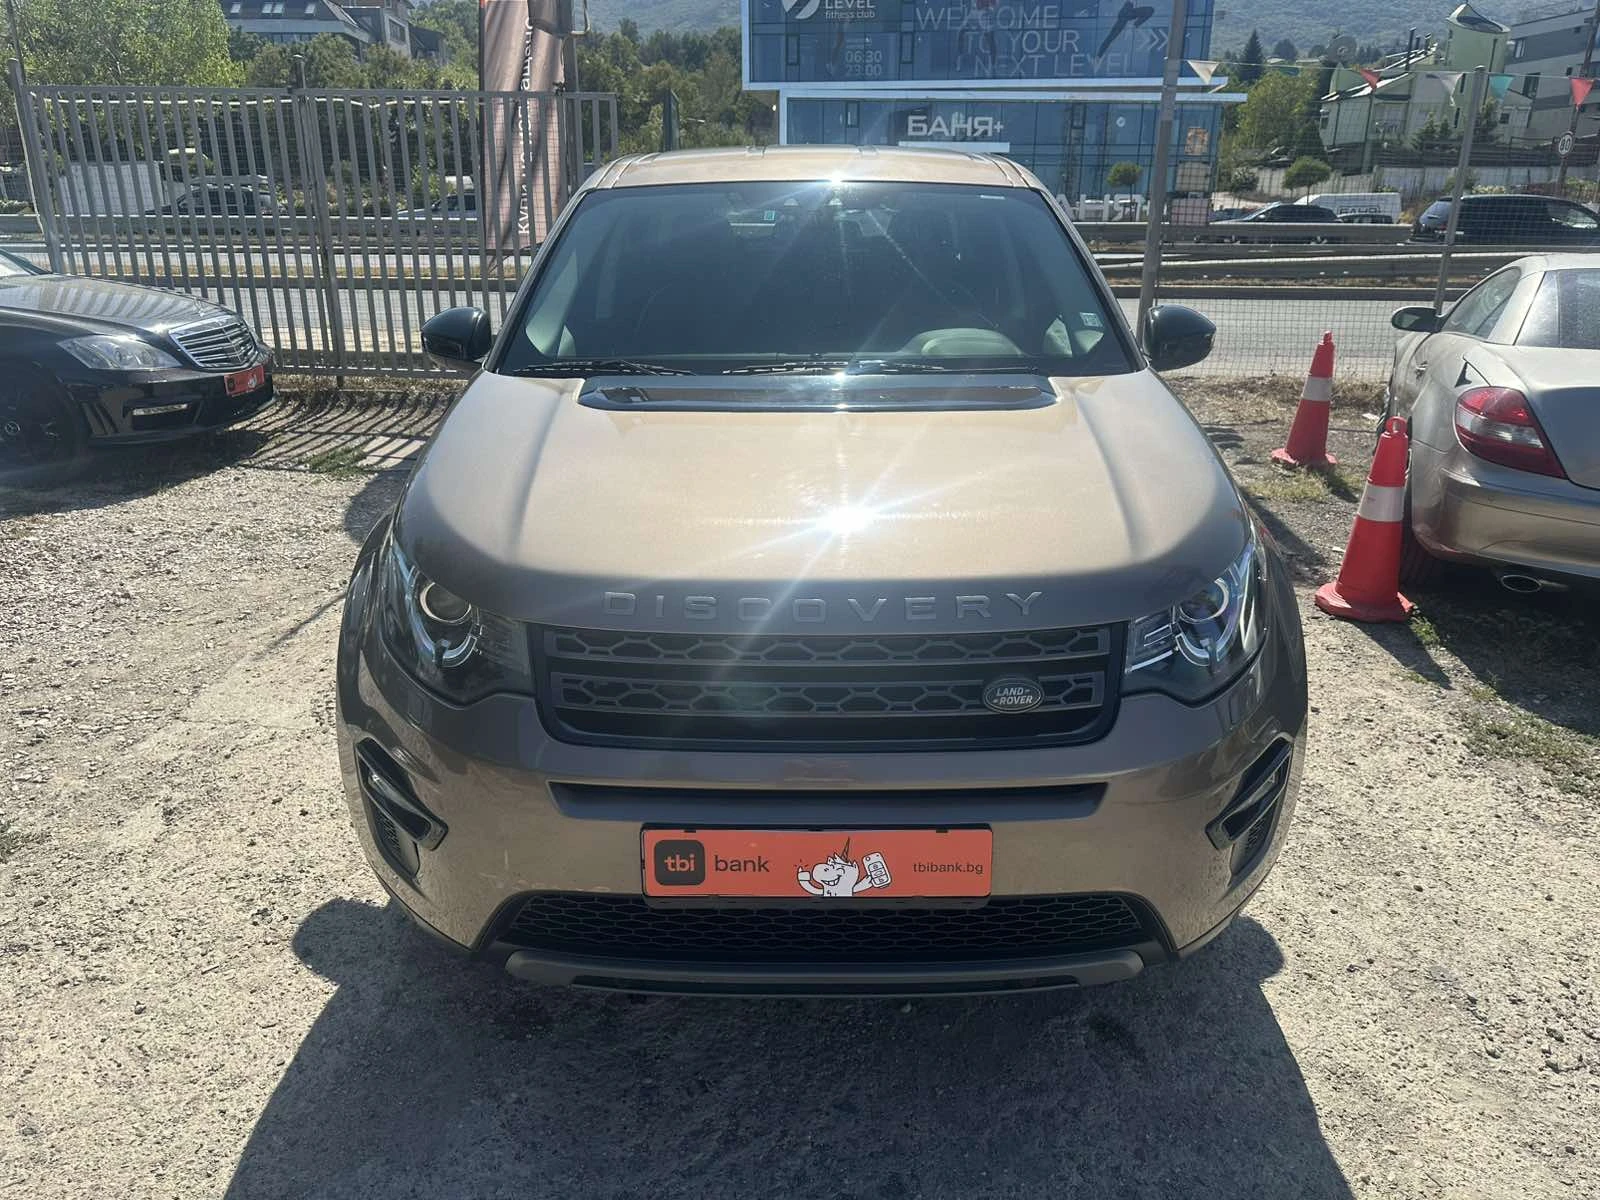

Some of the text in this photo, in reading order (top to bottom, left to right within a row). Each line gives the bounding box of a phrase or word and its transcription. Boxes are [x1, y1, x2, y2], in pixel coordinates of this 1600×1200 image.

[825, 0, 876, 9] LEVEL
[856, 9, 876, 18] club
[916, 5, 1058, 31] WELCOME
[966, 30, 1080, 54] TO YOUR
[845, 50, 882, 63] 06:30
[974, 53, 1137, 77] NEXT LEVEL
[603, 591, 1043, 623] DISCOVERY
[664, 854, 984, 875] tbi bank tbibank.bg
